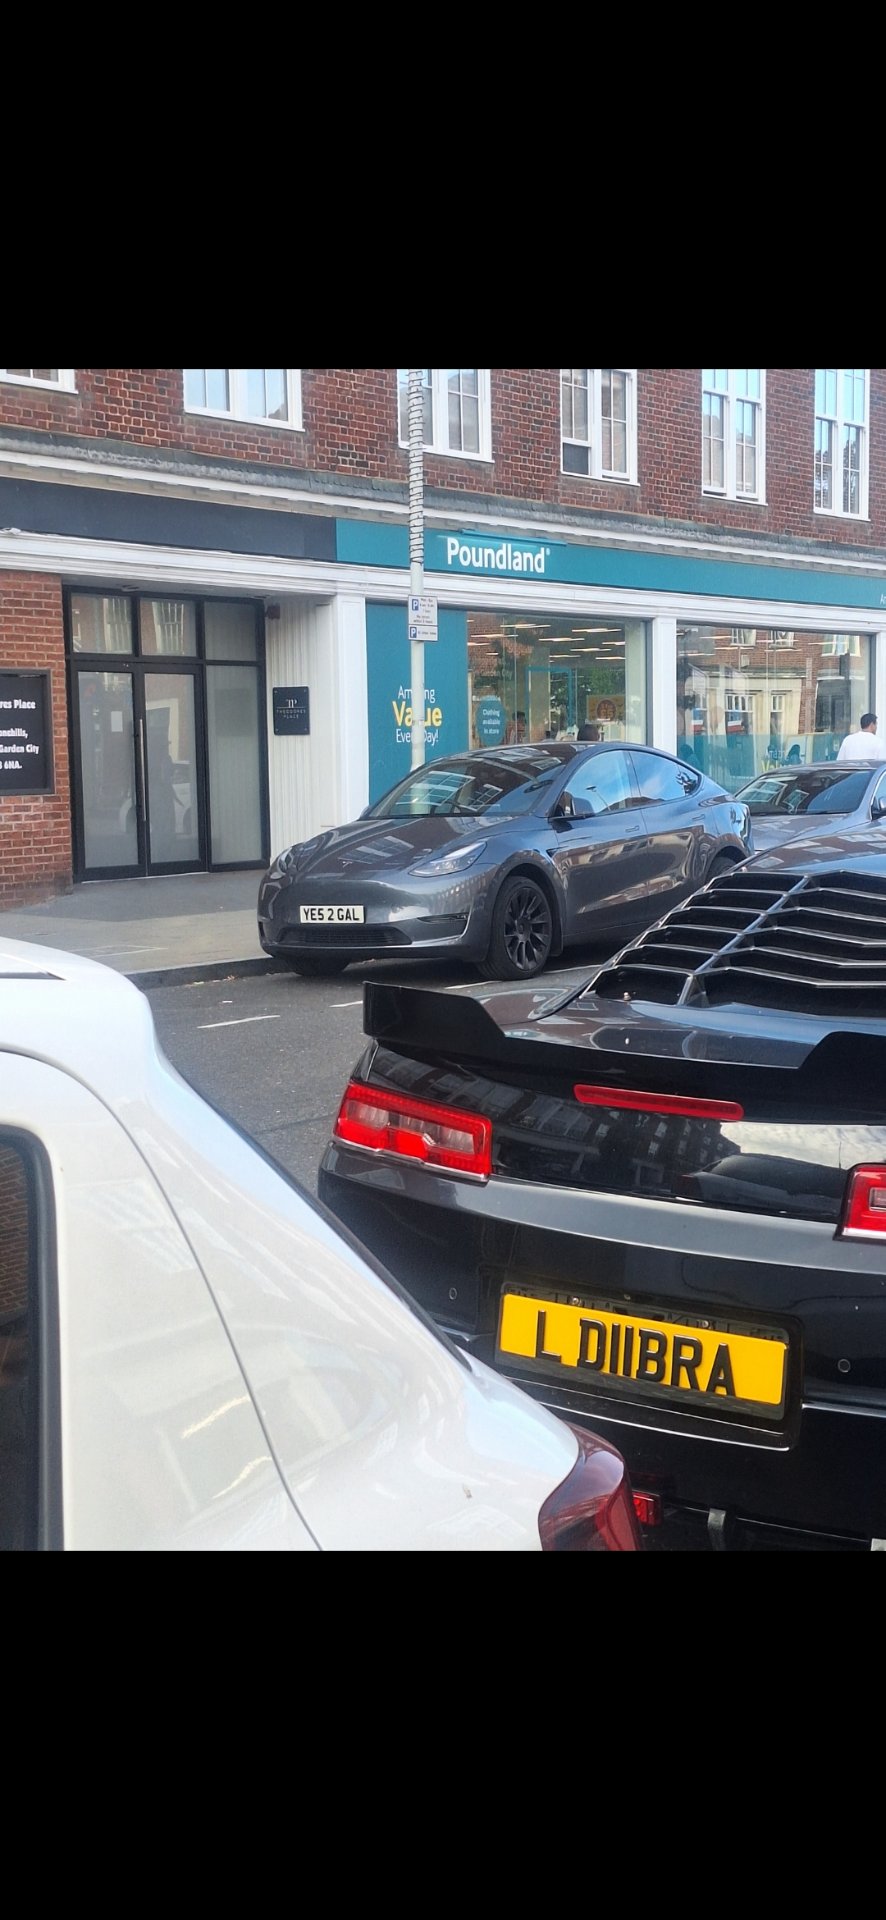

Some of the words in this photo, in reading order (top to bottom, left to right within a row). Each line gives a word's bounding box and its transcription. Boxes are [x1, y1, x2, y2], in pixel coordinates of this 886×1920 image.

[398, 685, 435, 704] Amng
[13, 699, 36, 709] Place
[392, 700, 442, 727] Vaue
[482, 708, 500, 717] Clothing
[26, 744, 39, 754] City
[327, 908, 334, 921] 2
[337, 908, 360, 921] GAL
[534, 1309, 562, 1363] L
